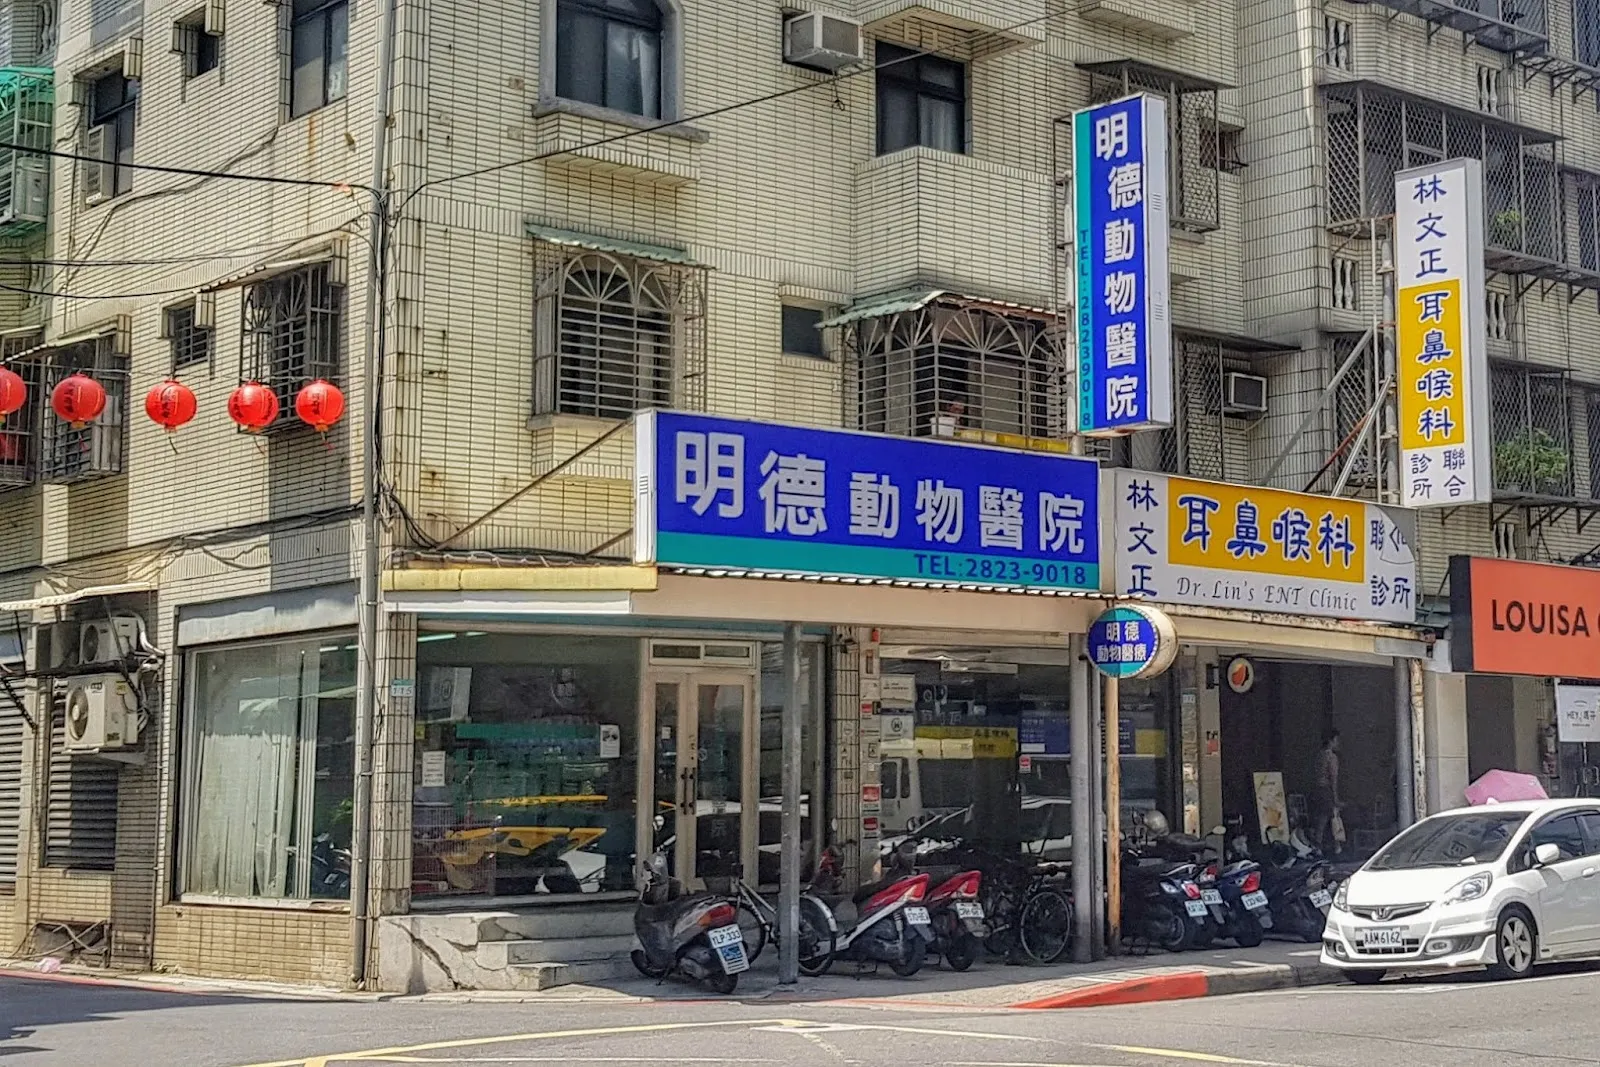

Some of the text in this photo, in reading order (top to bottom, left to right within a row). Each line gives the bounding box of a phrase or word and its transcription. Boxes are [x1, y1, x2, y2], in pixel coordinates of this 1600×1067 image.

[1413, 174, 1448, 278] 林文正
[1095, 111, 1144, 421] 明德動物醫院
[1414, 291, 1455, 441] 耳鼻喉科
[675, 431, 1085, 554] 明德動物醫院
[914, 553, 1087, 585] TEL:2823-9018
[1126, 479, 1159, 598] 林文正
[1177, 494, 1357, 569] 耳鼻喉科
[1176, 576, 1358, 611] Dr. Lin's ENT Clinic
[1370, 574, 1411, 610] 診所
[1491, 599, 1591, 638] LOUISA
[1106, 621, 1140, 642] 明德
